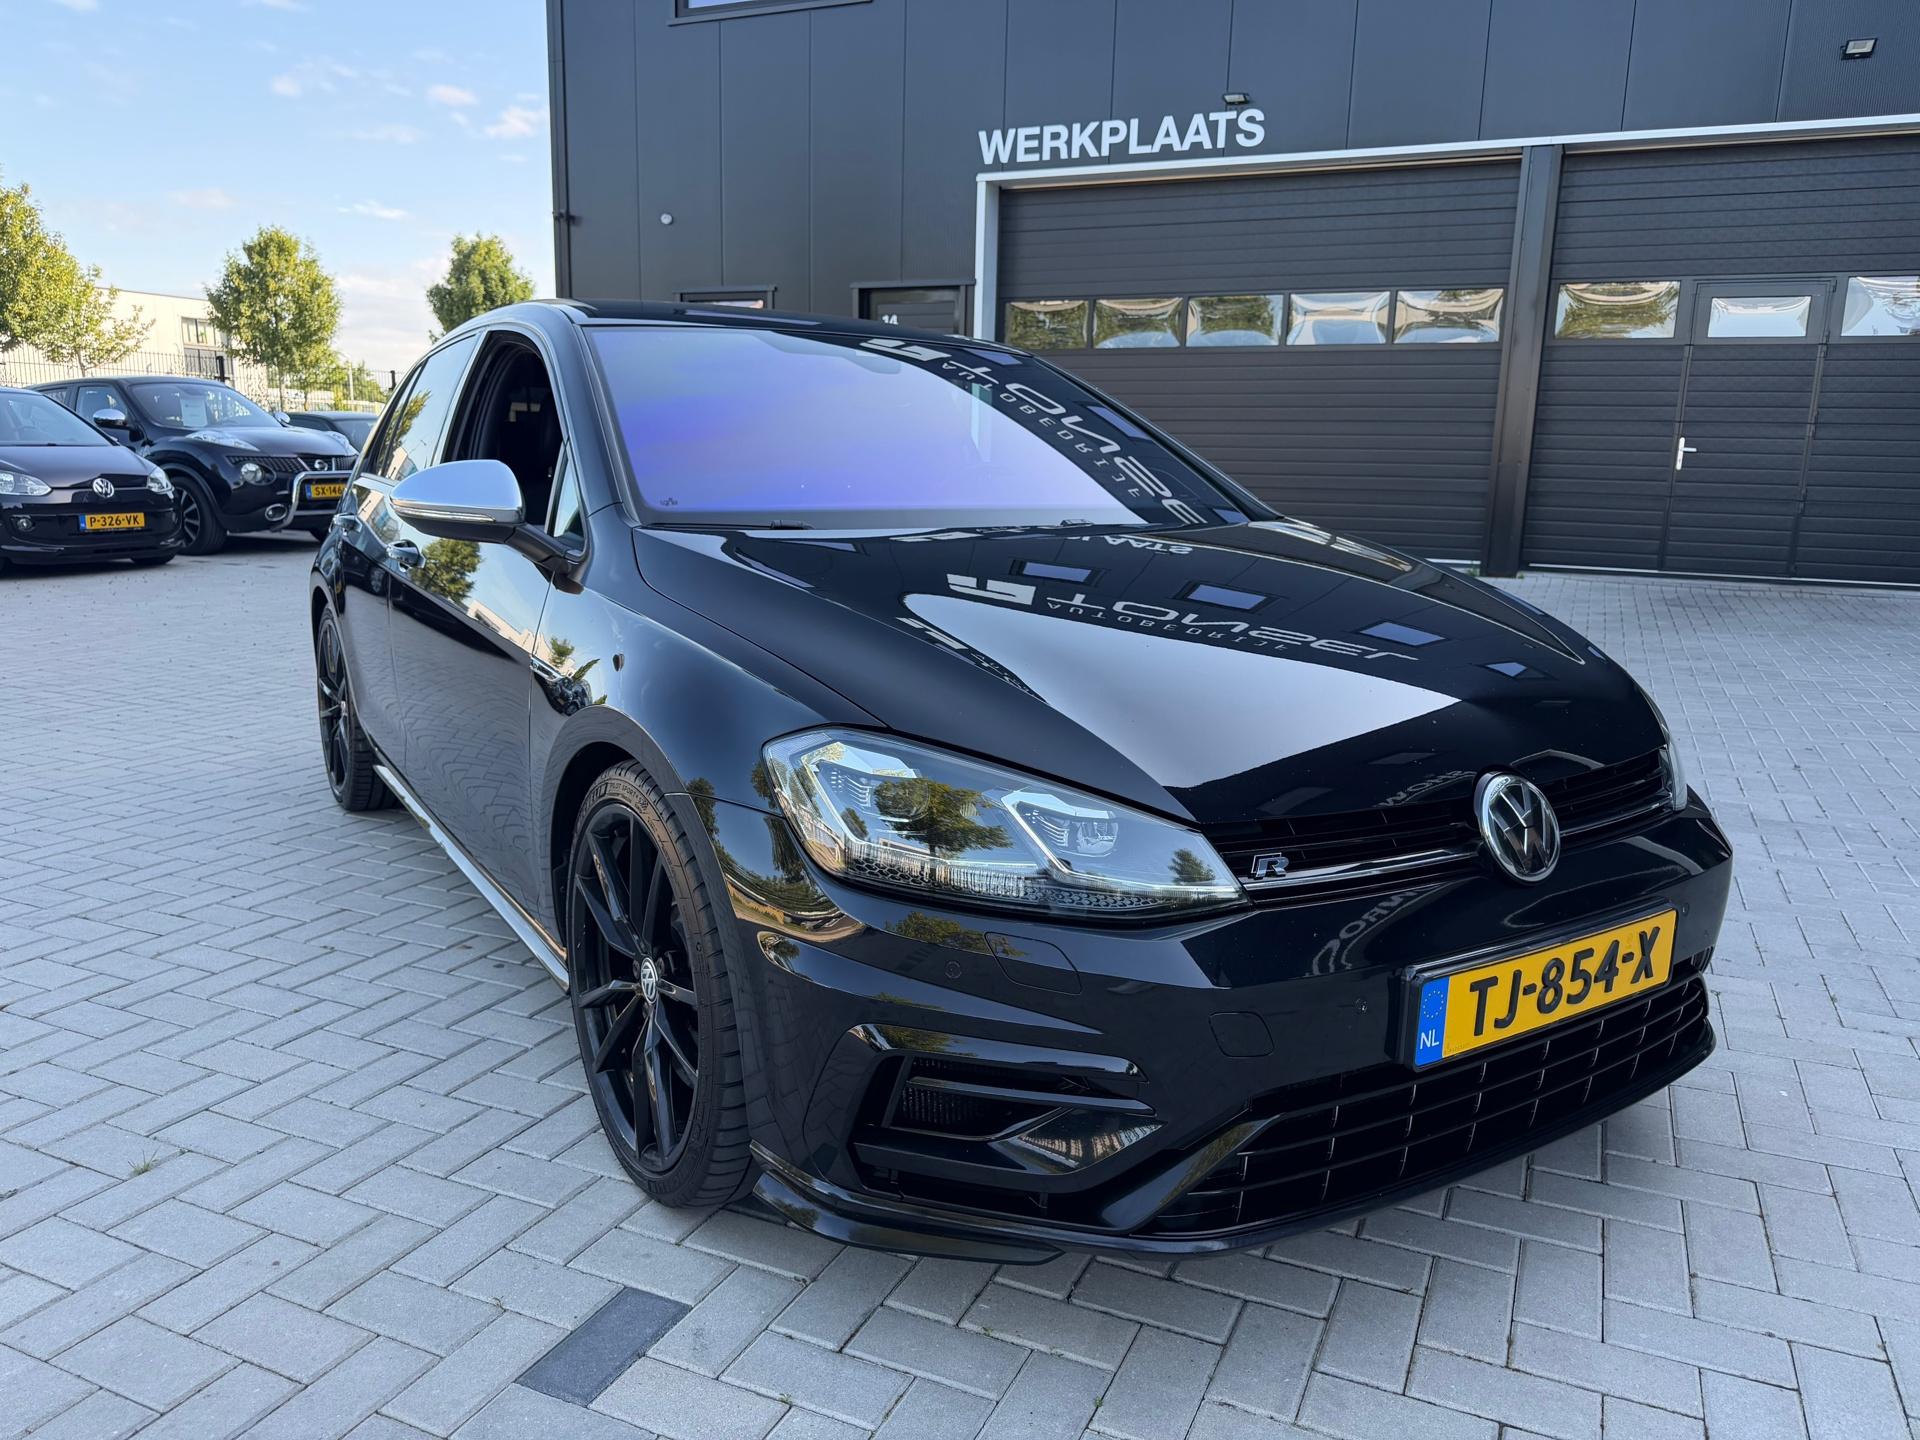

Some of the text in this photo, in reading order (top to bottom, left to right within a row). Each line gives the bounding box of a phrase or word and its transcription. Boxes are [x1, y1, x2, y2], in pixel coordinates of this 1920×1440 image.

[978, 108, 1265, 165] WERKPLAATS
[89, 514, 140, 527] P-326-VK
[1253, 853, 1290, 880] R
[1469, 926, 1661, 1037] TJ-854-X
[1419, 1028, 1440, 1050] NL
